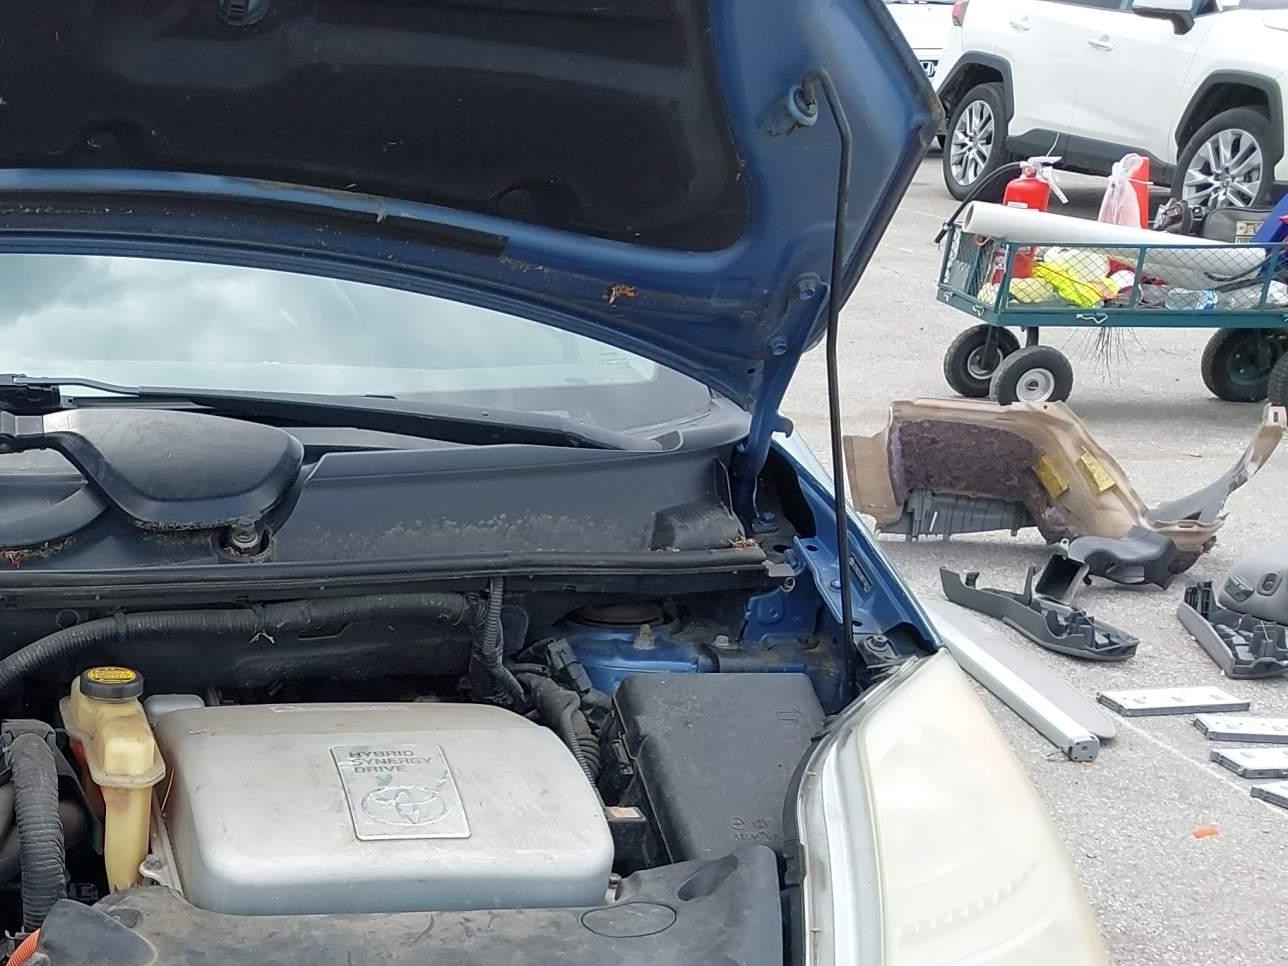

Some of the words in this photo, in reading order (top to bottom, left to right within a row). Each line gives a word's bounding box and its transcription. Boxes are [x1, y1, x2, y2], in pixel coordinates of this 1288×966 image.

[348, 750, 414, 758] HYBRID
[351, 757, 432, 766] SYNERGY
[354, 766, 409, 774] DRIVE
